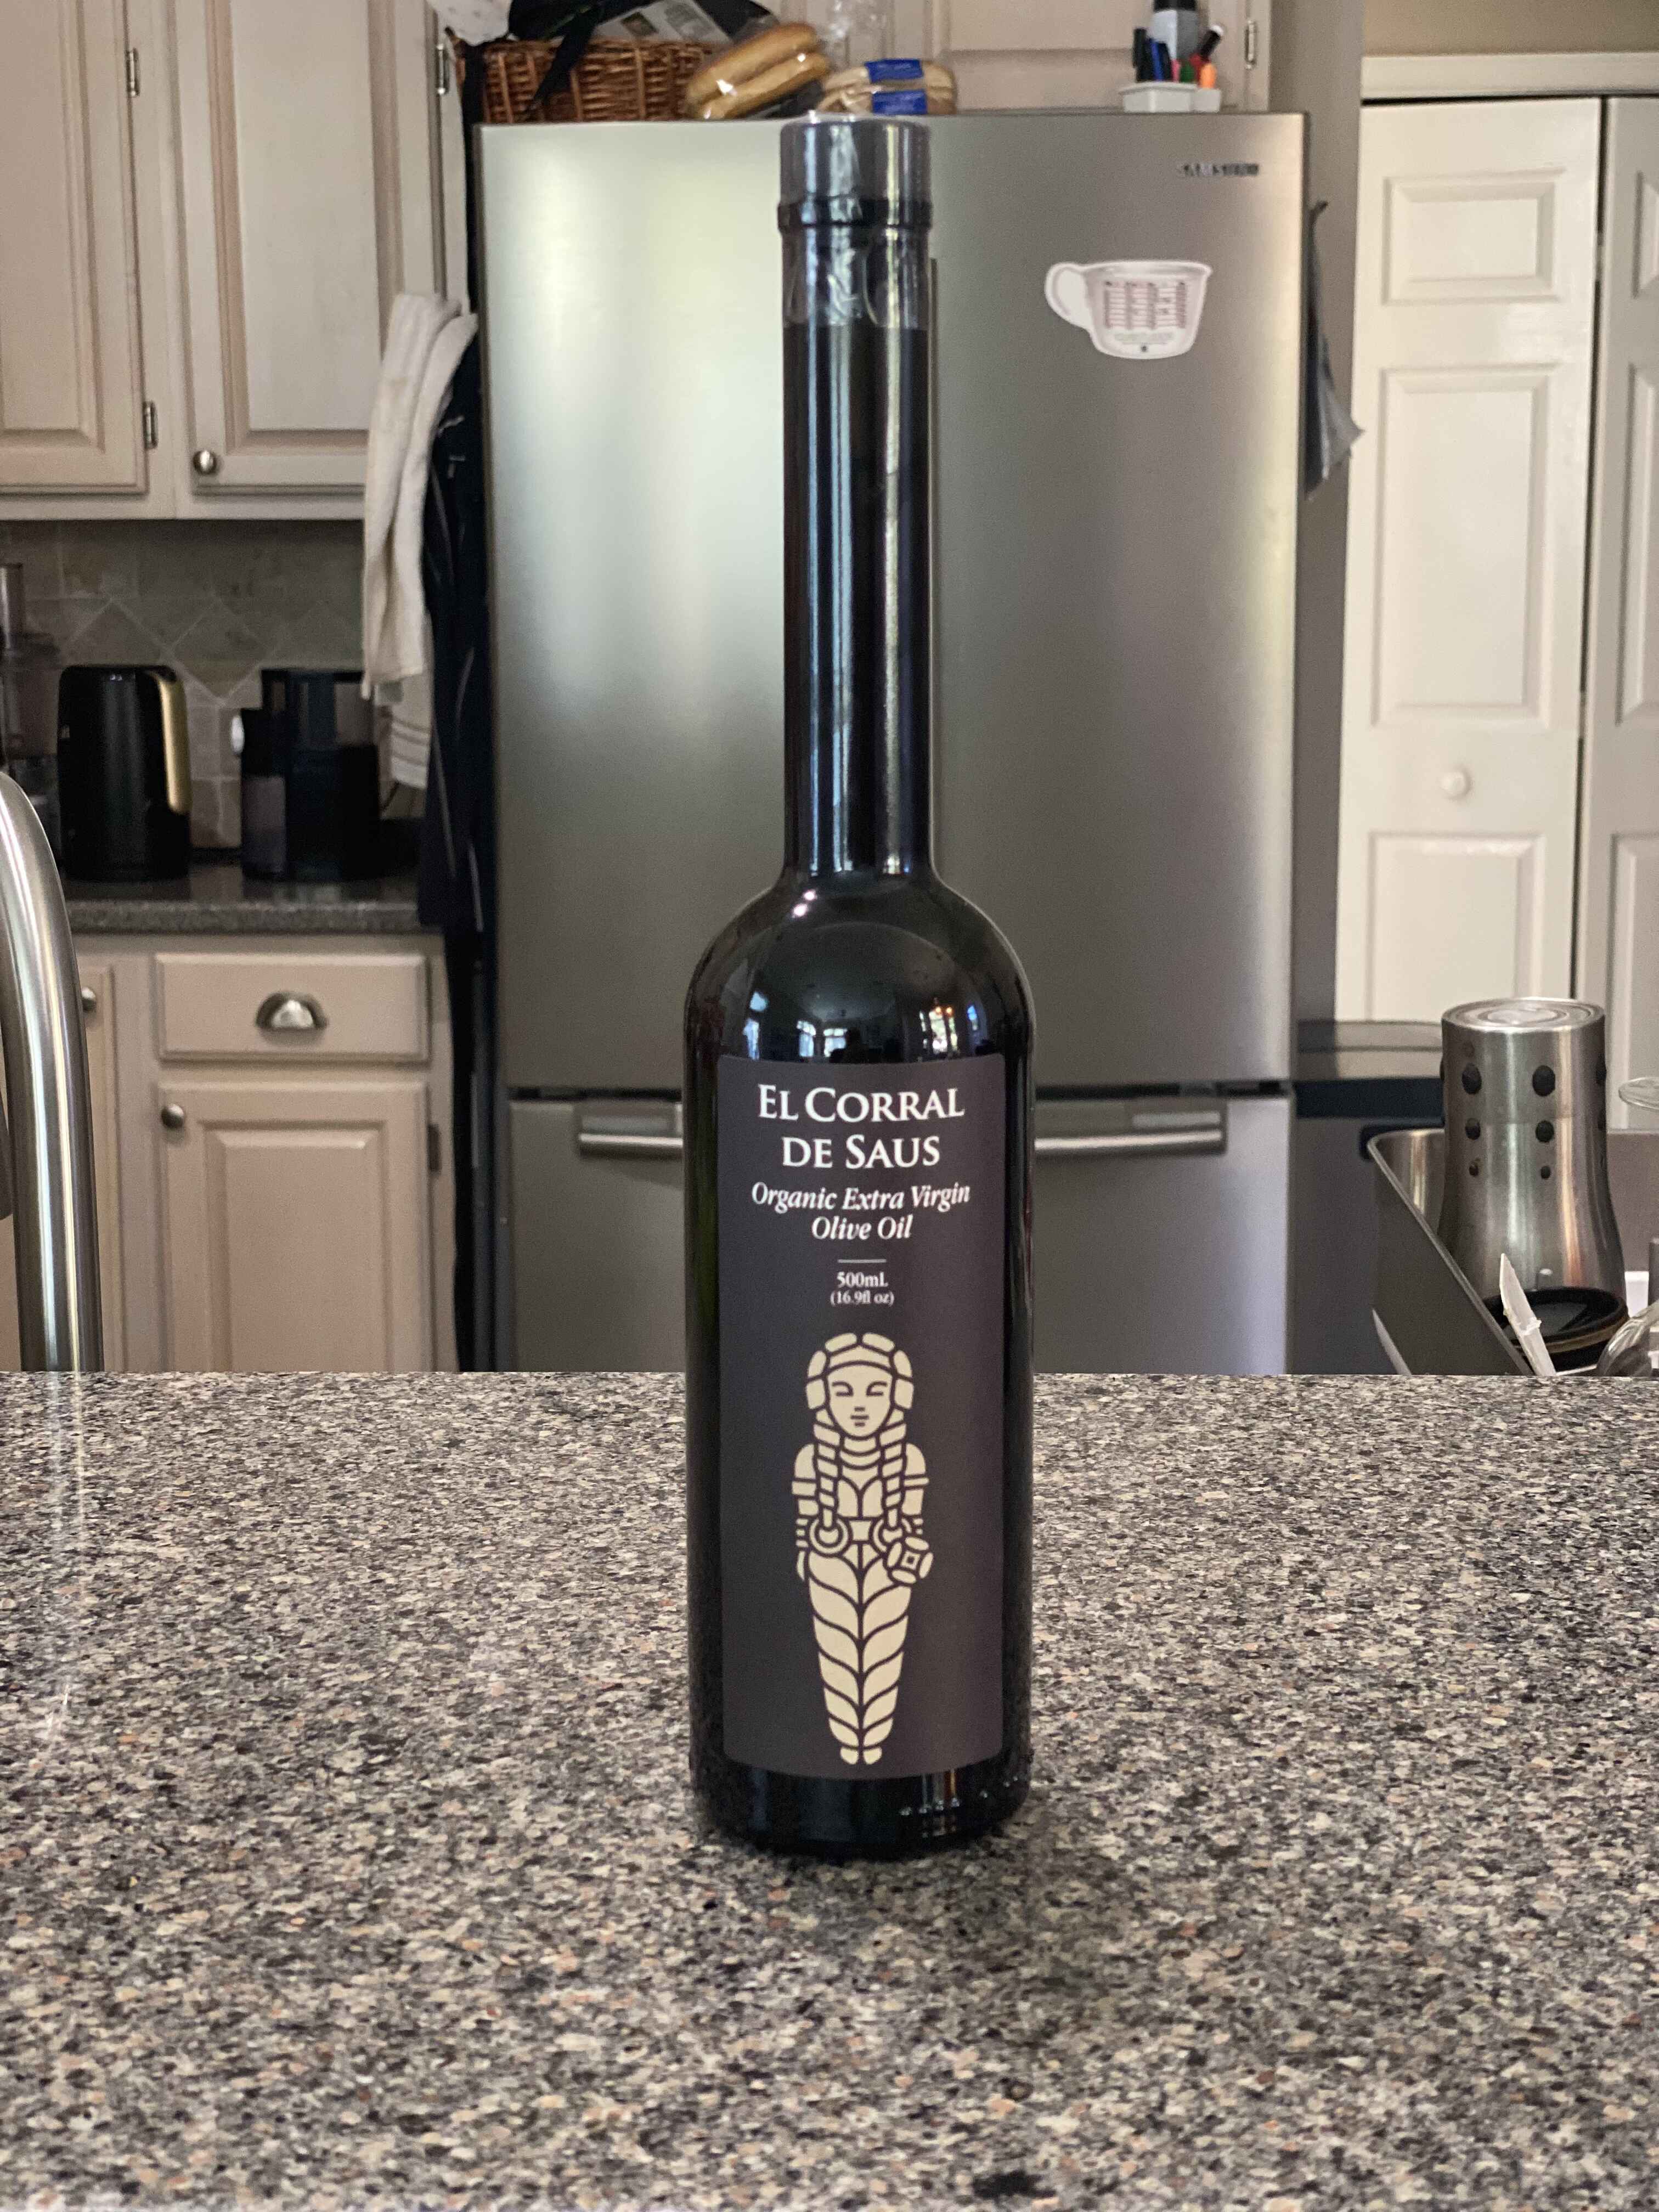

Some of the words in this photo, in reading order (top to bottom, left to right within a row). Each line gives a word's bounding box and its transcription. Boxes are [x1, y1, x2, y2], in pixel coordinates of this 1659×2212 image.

[758, 1084, 799, 1120] EL
[805, 1087, 965, 1122] CORRAL
[782, 1136, 833, 1169] DE
[845, 1134, 940, 1169] SAUS
[752, 1182, 837, 1214] Organic
[842, 1187, 905, 1210] Extra
[911, 1182, 970, 1212] Virgin
[811, 1215, 872, 1240] Olive
[877, 1214, 913, 1240] Oil
[837, 1271, 889, 1288] 500mL
[830, 1290, 871, 1306] (16.9fl
[873, 1290, 895, 1306] oz)
